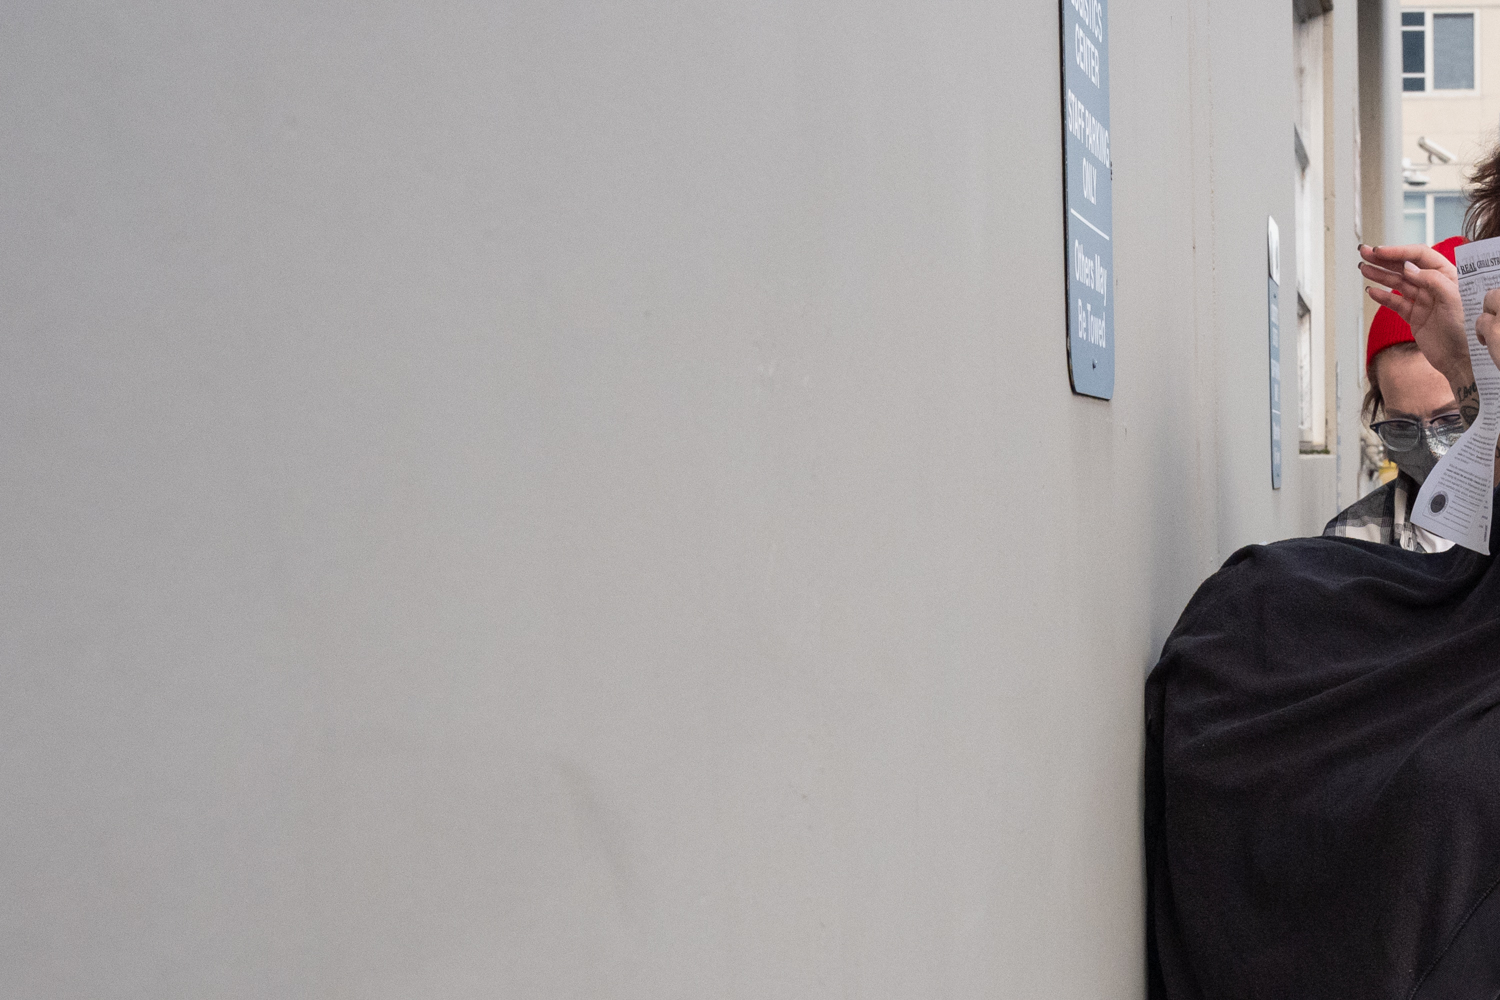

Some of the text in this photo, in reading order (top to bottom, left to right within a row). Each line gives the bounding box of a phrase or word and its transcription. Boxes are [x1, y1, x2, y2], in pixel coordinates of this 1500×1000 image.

[1070, 0, 1102, 43] STICS
[1075, 23, 1100, 89] CENTER
[1068, 88, 1110, 169] STAFF PARKING
[1082, 157, 1097, 205] ONLY
[1074, 238, 1107, 307] Others May
[1461, 262, 1477, 275] REAL
[1078, 298, 1106, 349] Be Towed
